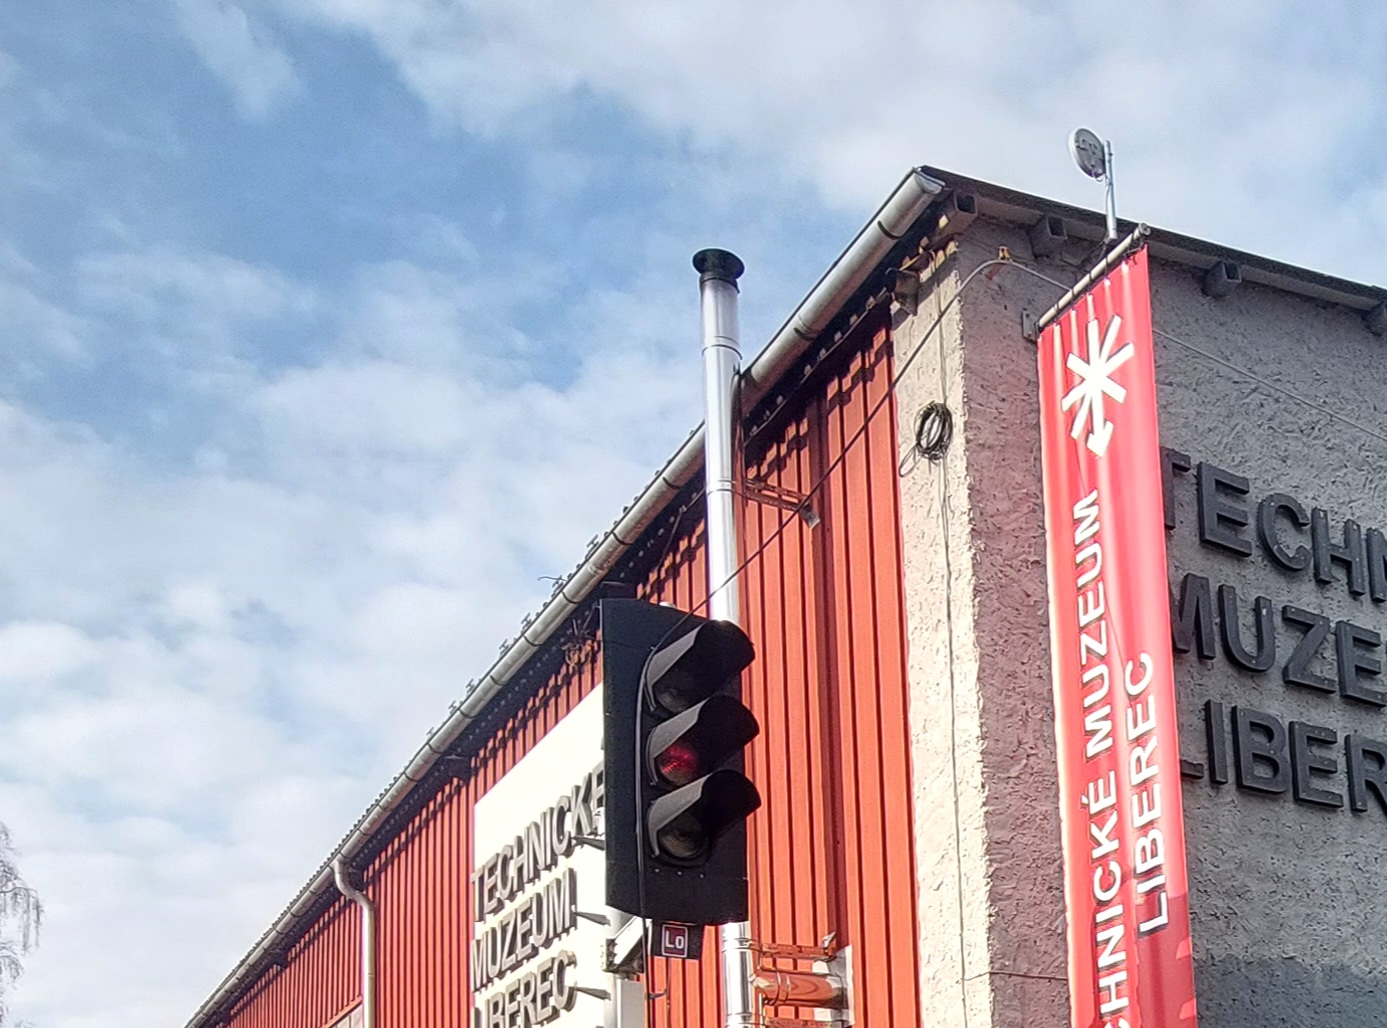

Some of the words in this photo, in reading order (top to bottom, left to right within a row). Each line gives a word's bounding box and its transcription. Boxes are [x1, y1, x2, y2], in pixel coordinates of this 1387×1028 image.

[1073, 490, 1114, 762] MUZEUM
[470, 866, 578, 992] MUZEUM
[1124, 651, 1168, 936] LIBEREC
